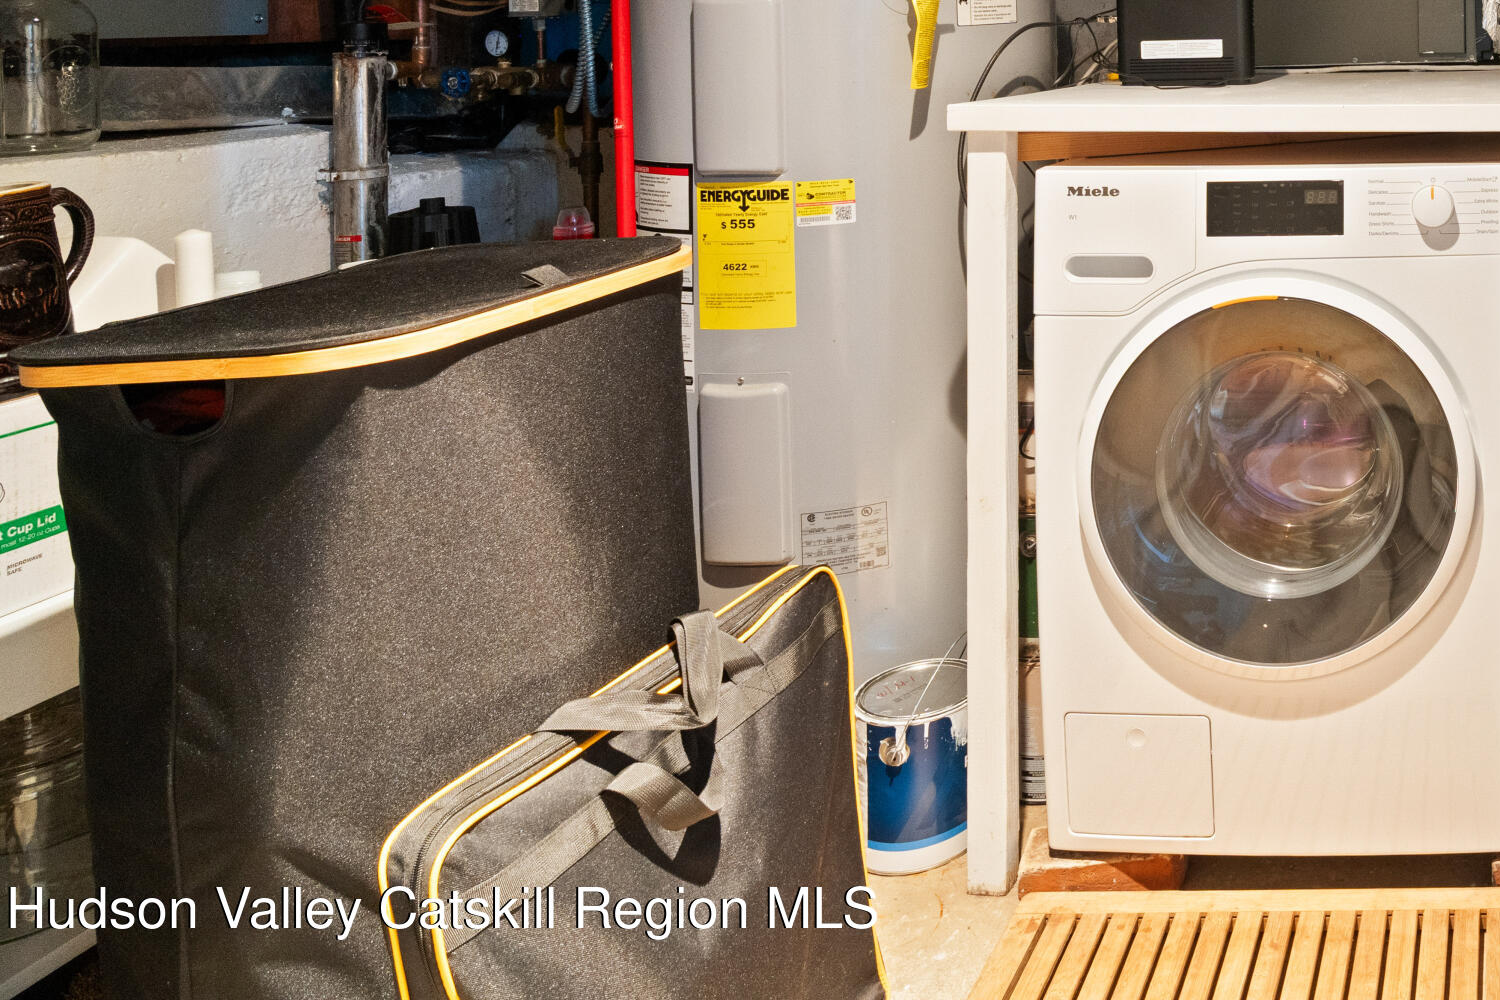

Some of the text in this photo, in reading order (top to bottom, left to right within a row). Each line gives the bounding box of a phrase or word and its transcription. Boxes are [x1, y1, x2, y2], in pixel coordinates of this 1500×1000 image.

[700, 188, 790, 205] ENERGYGUIDE
[1067, 186, 1120, 197] Miele
[721, 219, 755, 229] $ 555
[723, 263, 748, 271] 4622
[7, 523, 34, 538] Cup
[37, 512, 57, 528] Lid
[7, 553, 43, 570] MICROWAVE
[7, 566, 22, 577] SAFE
